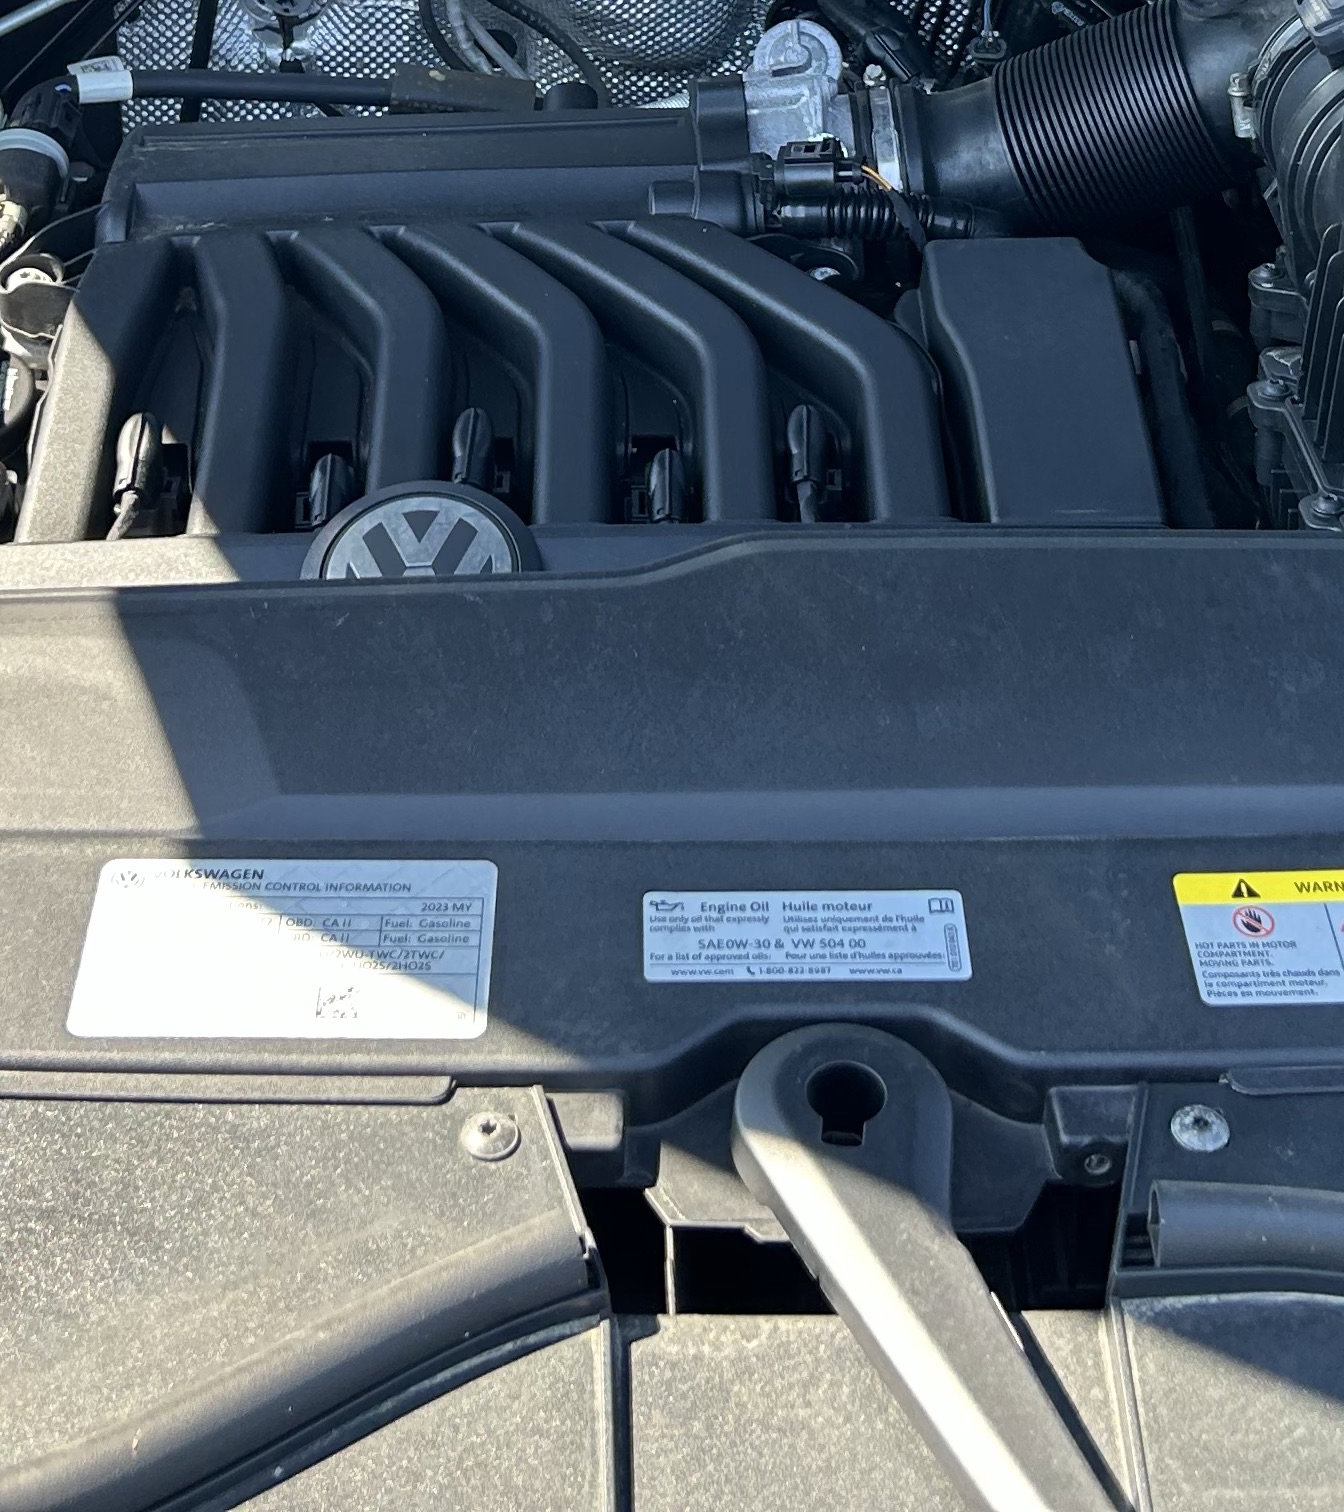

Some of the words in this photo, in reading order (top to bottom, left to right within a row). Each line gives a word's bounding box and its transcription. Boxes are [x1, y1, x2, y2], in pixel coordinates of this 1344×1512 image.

[264, 882, 322, 892] CONTROL
[325, 882, 412, 893] INFORMATION
[420, 901, 449, 912] 2023
[451, 901, 472, 912] MY
[700, 901, 747, 915] Engine
[750, 901, 769, 912] Oil
[782, 900, 818, 912] Huile
[821, 901, 873, 912] moteur
[384, 917, 413, 929] Fuel:
[418, 917, 471, 929] Gasoline
[649, 915, 667, 923] Use
[668, 915, 689, 925] only
[690, 915, 703, 923] oil
[704, 915, 724, 923] that
[725, 915, 770, 925] expressly
[782, 914, 818, 923] Utilisez
[820, 914, 880, 924] uniquement
[881, 914, 894, 923] de
[895, 914, 925, 923] l'huile
[649, 924, 692, 934] complies
[692, 924, 715, 933] with
[783, 925, 800, 934] qui
[801, 924, 839, 933] satisfait
[382, 932, 412, 944] Fuel:
[416, 932, 470, 944] Gasoline
[774, 938, 785, 949] &
[791, 938, 816, 949] VW
[819, 938, 845, 949] 504
[848, 938, 867, 949] 00
[1194, 941, 1215, 950] HOT
[1217, 941, 1247, 949] PARTS
[1249, 940, 1260, 949] IN
[1261, 940, 1297, 949] MOTOR
[649, 952, 665, 961] For
[674, 952, 690, 961] list
[691, 952, 702, 960] of
[704, 952, 750, 963] approved
[785, 951, 807, 960] Pour
[809, 952, 827, 960] une
[828, 951, 849, 960] liste
[1197, 950, 1274, 958] COMPARTMENT.
[1199, 959, 1239, 968] MOVING
[1241, 958, 1274, 967] PARTS.
[670, 968, 735, 976] www.vw.com
[848, 966, 903, 975] www.vw.ca
[1202, 969, 1261, 980] Composants
[1262, 969, 1280, 978] très
[1281, 968, 1316, 978] chauds
[1317, 968, 1341, 977] dans
[1215, 979, 1286, 990] compartiment
[1206, 989, 1239, 998] Pièces
[1240, 989, 1253, 997] en
[1255, 988, 1319, 997] mouvement.
